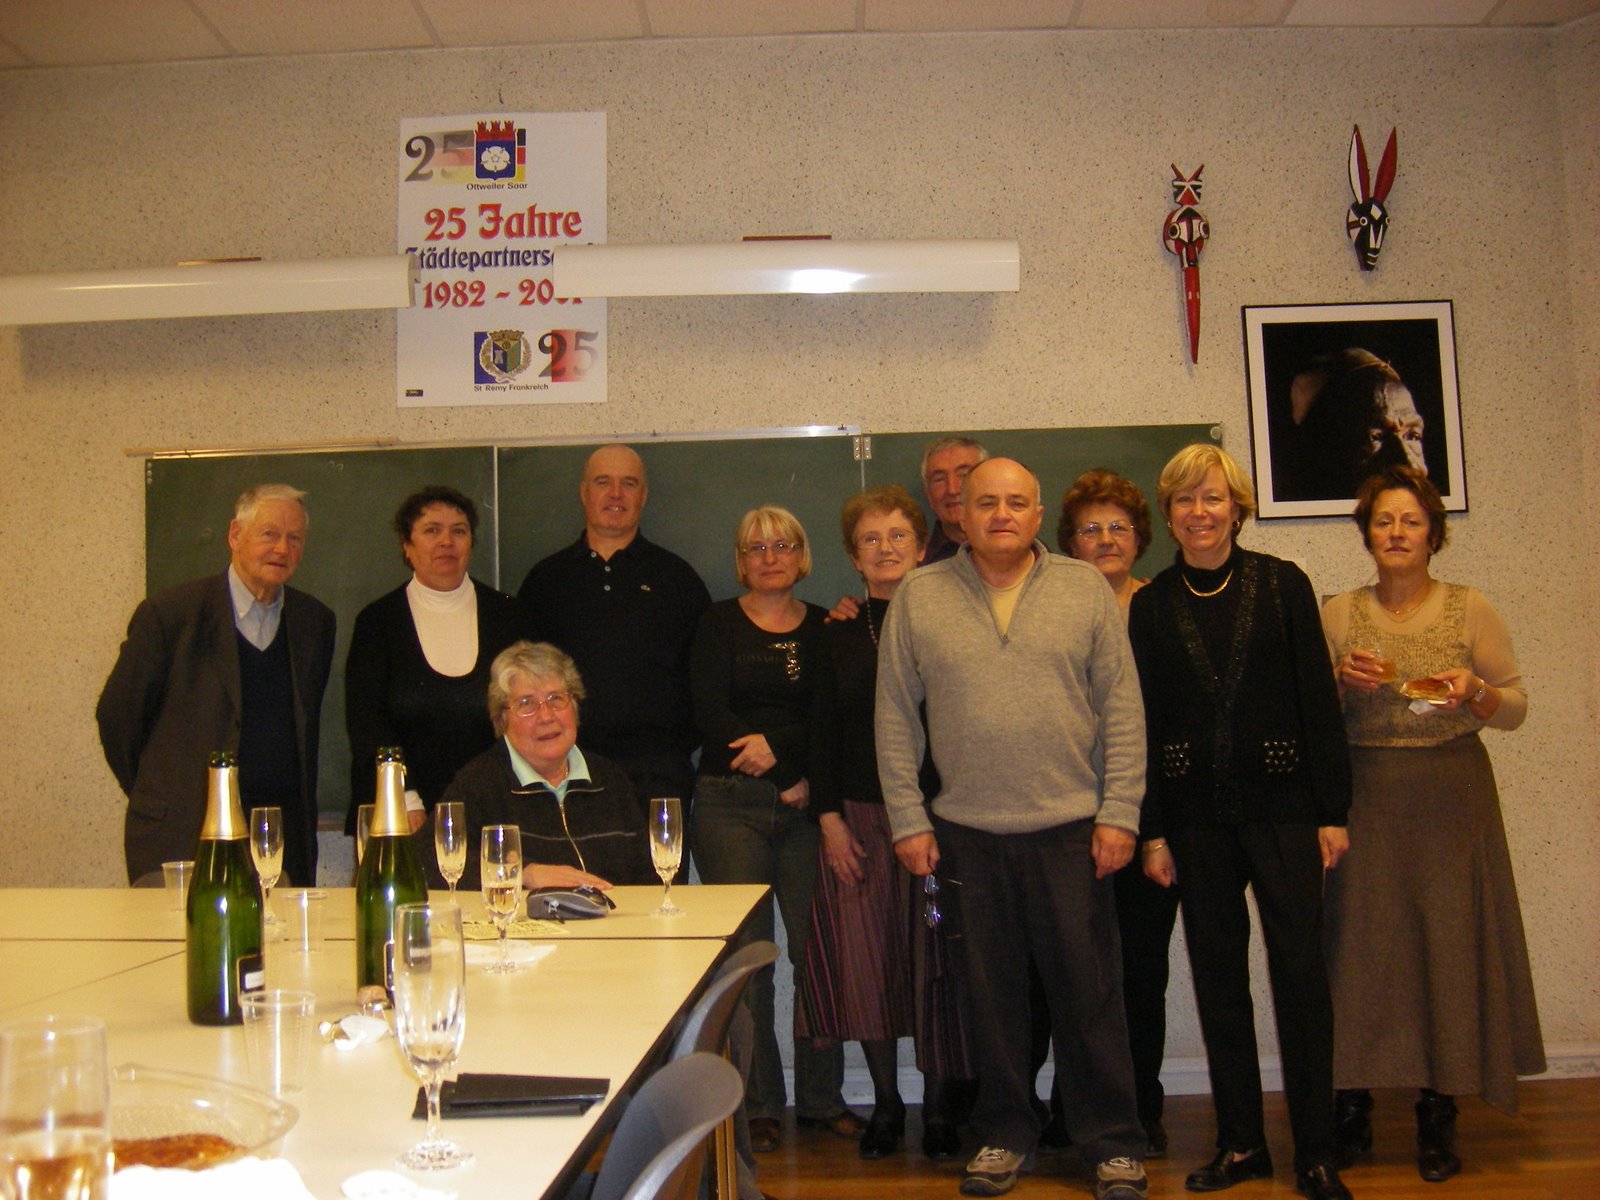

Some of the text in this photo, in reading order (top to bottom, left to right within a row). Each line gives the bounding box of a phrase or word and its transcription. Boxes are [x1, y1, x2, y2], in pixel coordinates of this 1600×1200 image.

[404, 134, 470, 182] 25
[466, 181, 529, 191] Ottweiler Saar
[424, 202, 583, 241] 25 Jahre
[405, 242, 593, 272] tädtepartners
[423, 279, 486, 309] 1982
[518, 278, 584, 306] 20
[538, 331, 600, 378] 25
[508, 383, 549, 392] Frankreich
